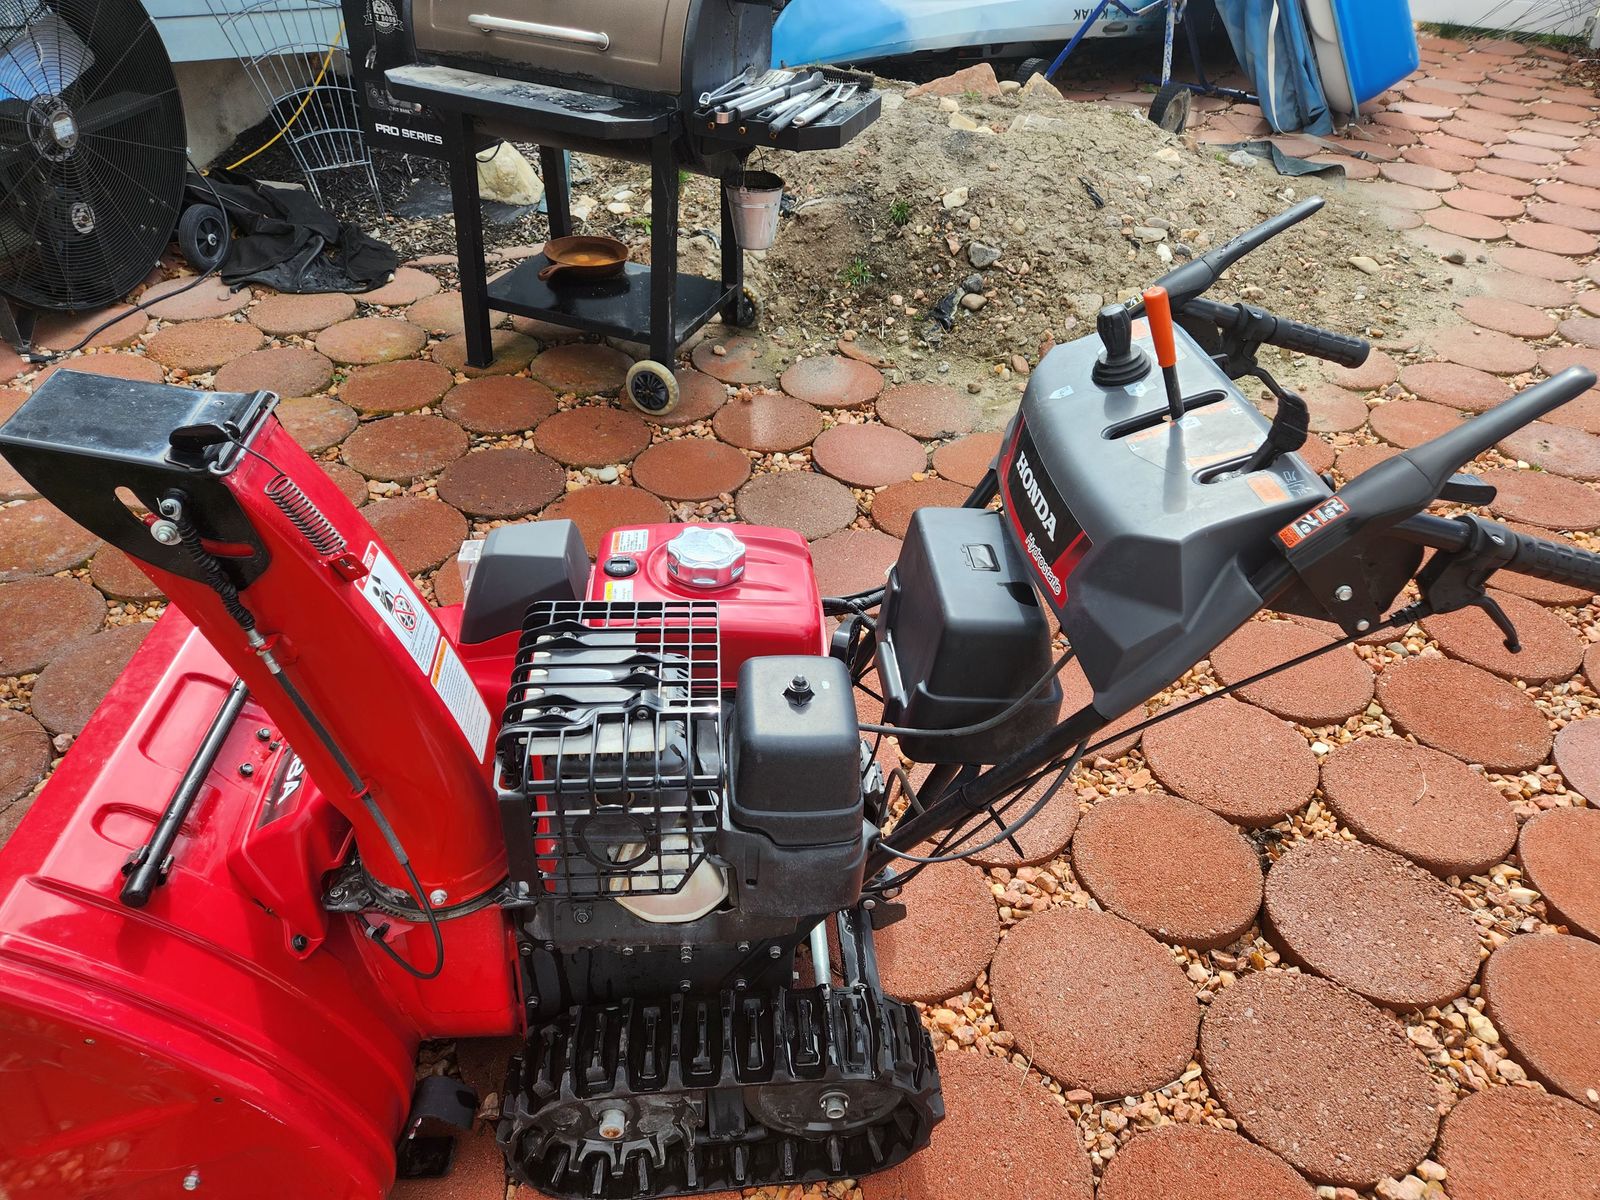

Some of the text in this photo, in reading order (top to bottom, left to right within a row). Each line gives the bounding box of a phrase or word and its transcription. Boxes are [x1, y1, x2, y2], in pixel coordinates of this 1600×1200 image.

[375, 123, 443, 145] PRO SERIES
[1016, 450, 1057, 542] HONDA
[1024, 532, 1061, 596] Hydrostatic
